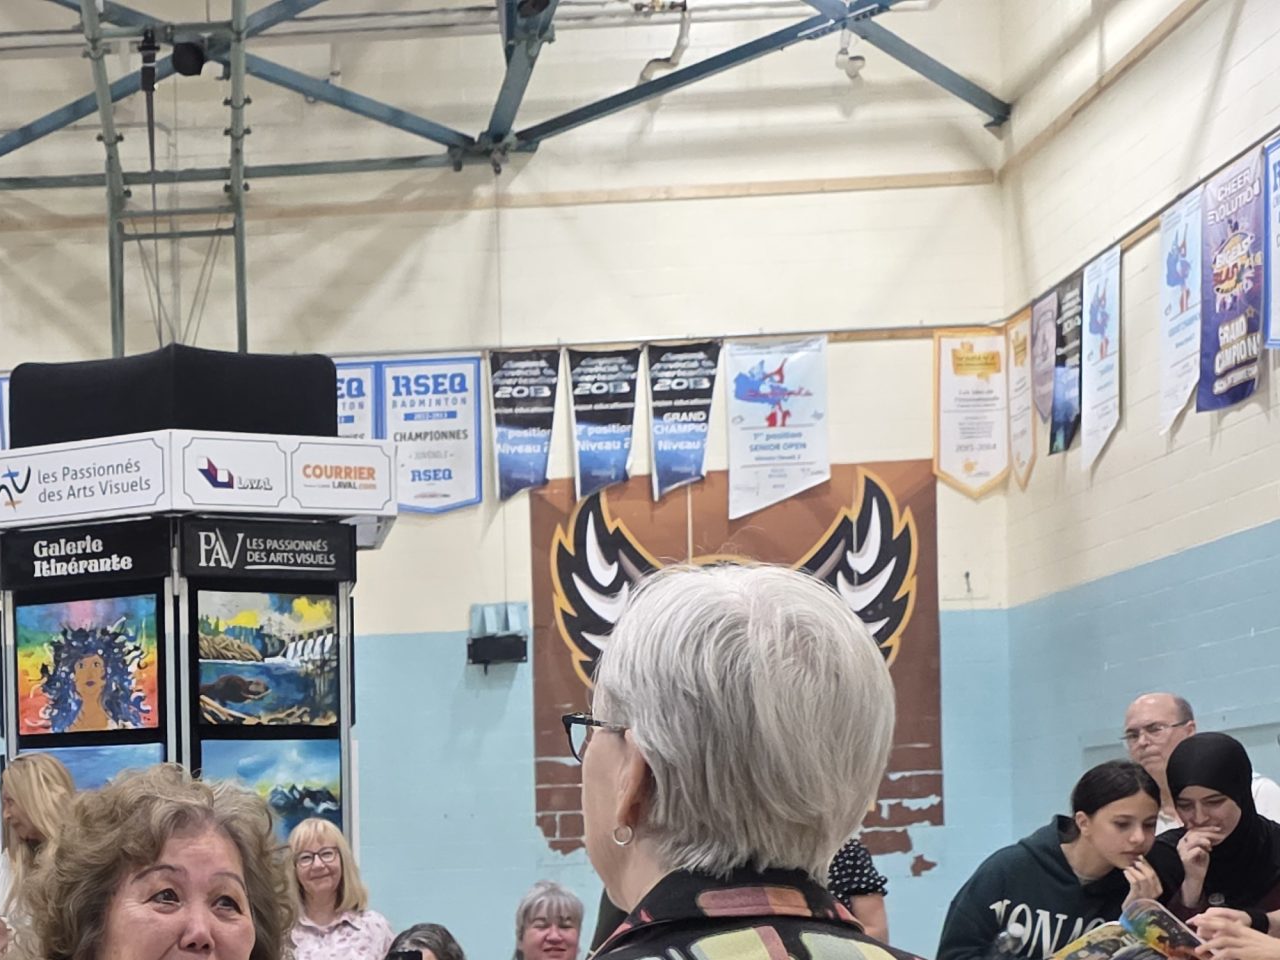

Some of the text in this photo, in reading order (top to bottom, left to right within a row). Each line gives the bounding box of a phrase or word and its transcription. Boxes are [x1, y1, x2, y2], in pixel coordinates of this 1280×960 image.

[392, 373, 469, 397] RSEQ
[392, 397, 467, 410] BADMINTON
[663, 411, 707, 423] GRAND
[393, 429, 469, 443] CHAMPIONNES
[654, 422, 708, 435] CHAMPIO
[38, 458, 141, 485] les Passionnés
[302, 464, 376, 481] COURRIER
[410, 468, 453, 482] RSEQ
[38, 477, 151, 503] des Arts Visuels
[237, 476, 273, 491] LAVAL
[33, 535, 103, 558] Galerie
[198, 528, 245, 569] PAV
[246, 538, 329, 552] LES PASSIONNÉS
[33, 553, 133, 577] Itinérante
[246, 551, 337, 566] DES ARTS VISUELS
